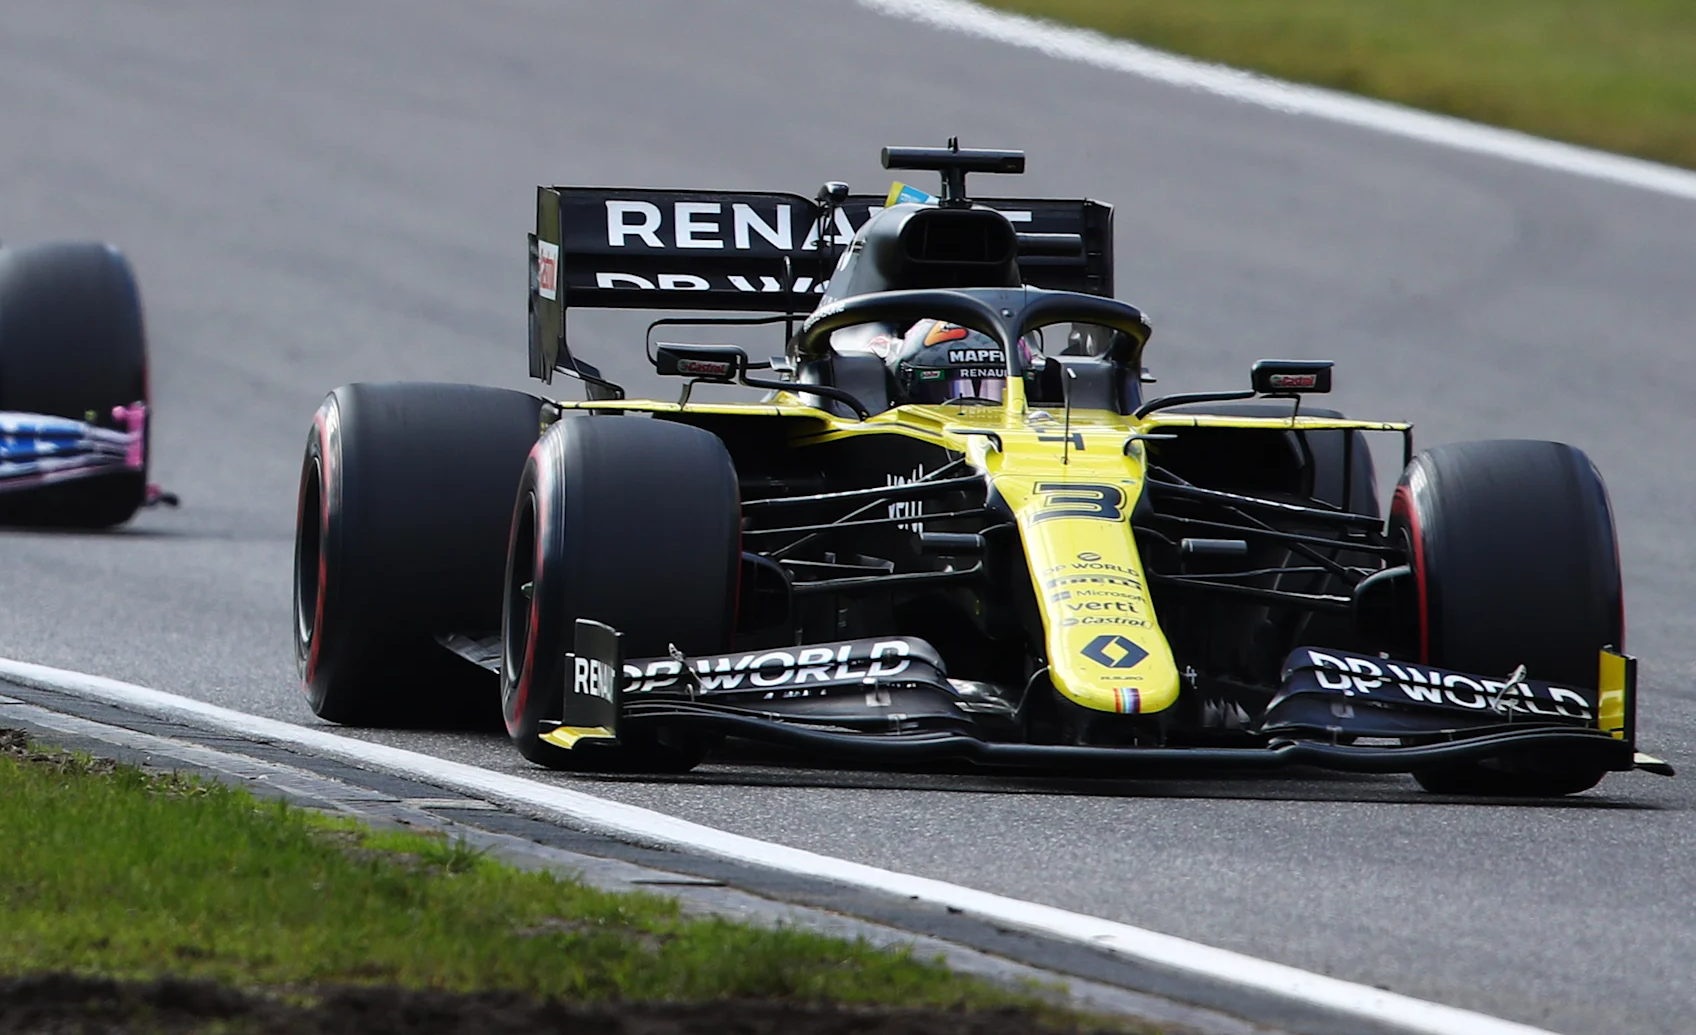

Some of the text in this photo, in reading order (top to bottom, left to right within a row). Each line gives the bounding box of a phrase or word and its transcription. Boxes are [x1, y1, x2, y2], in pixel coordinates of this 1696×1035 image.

[949, 350, 1005, 362] MAPF
[960, 368, 1007, 378] RENAU
[1031, 481, 1127, 524] 3
[1072, 563, 1140, 577] WORLD
[1076, 590, 1147, 604] Microsoft
[1067, 602, 1139, 614] verti
[1081, 616, 1146, 626] Castrol
[696, 641, 911, 691] WORLD
[1307, 650, 1383, 694] DP
[1387, 664, 1593, 720] WORLD
